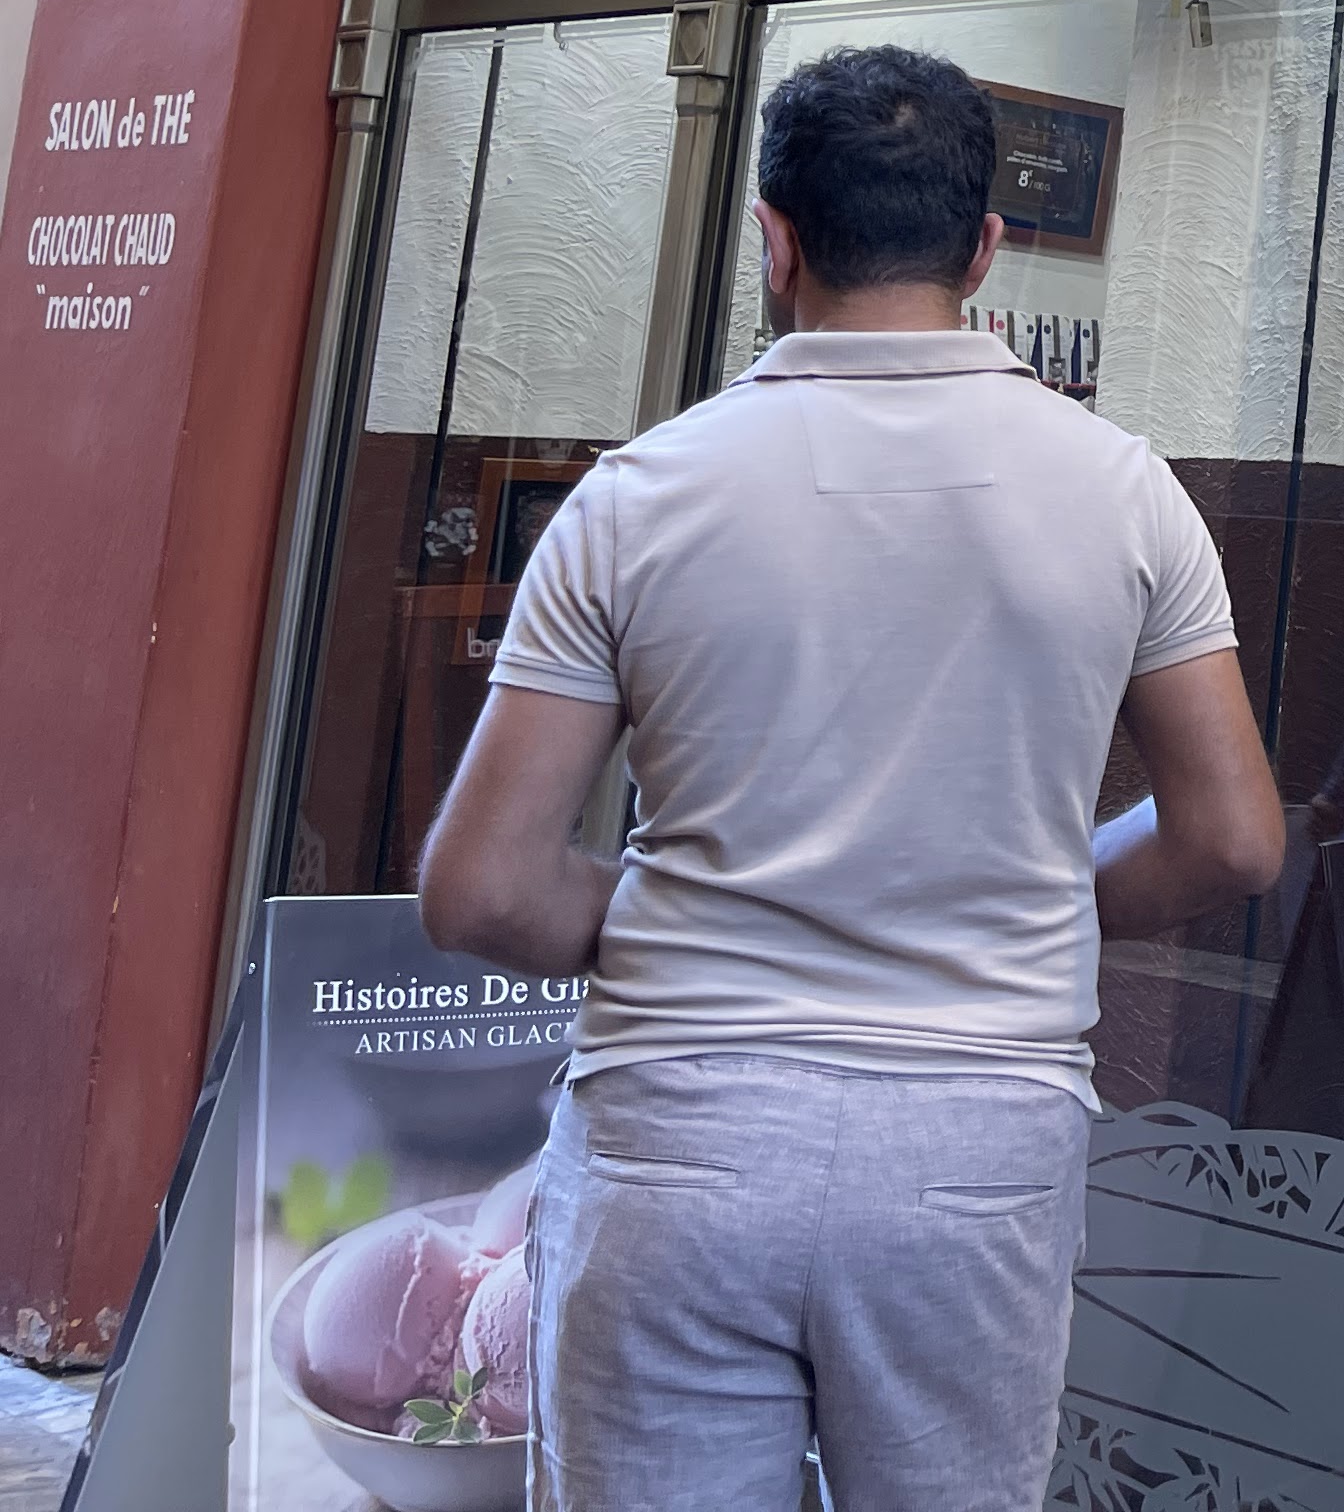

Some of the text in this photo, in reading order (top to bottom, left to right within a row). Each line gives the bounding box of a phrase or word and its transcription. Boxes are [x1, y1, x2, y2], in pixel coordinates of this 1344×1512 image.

[45, 99, 116, 151] SALON
[117, 97, 146, 148] de
[27, 213, 176, 267] CHOCOLAT CHAUD
[311, 977, 469, 1014] Histoires
[481, 974, 529, 1006] De
[354, 1027, 477, 1055] ARTISAN
